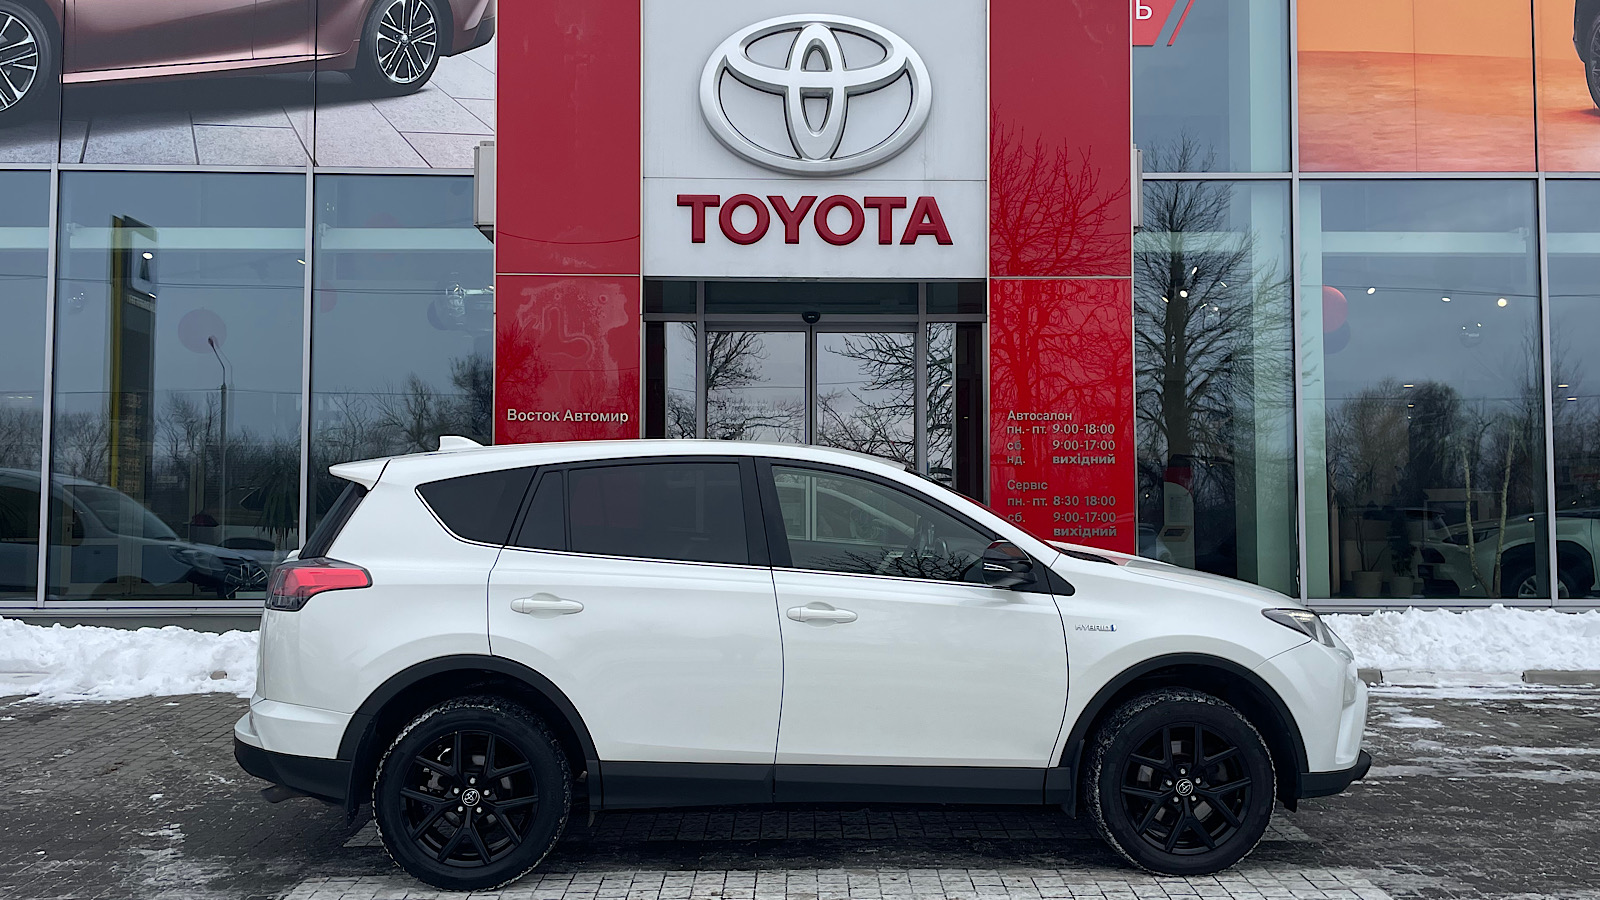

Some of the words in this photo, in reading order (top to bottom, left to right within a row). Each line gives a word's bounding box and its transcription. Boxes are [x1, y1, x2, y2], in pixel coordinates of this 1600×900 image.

[677, 193, 953, 246] TOYOTA
[507, 408, 560, 422] Восток
[563, 409, 629, 425] Автомир
[1007, 410, 1073, 421] Автосалон
[1007, 440, 1025, 451] сб.
[1052, 439, 1116, 451] 9:00-17:00
[1007, 456, 1026, 466] нд.
[1052, 453, 1116, 466] вихідний
[1053, 511, 1117, 523] 9:00-17:00
[1053, 525, 1118, 538] вихідний
